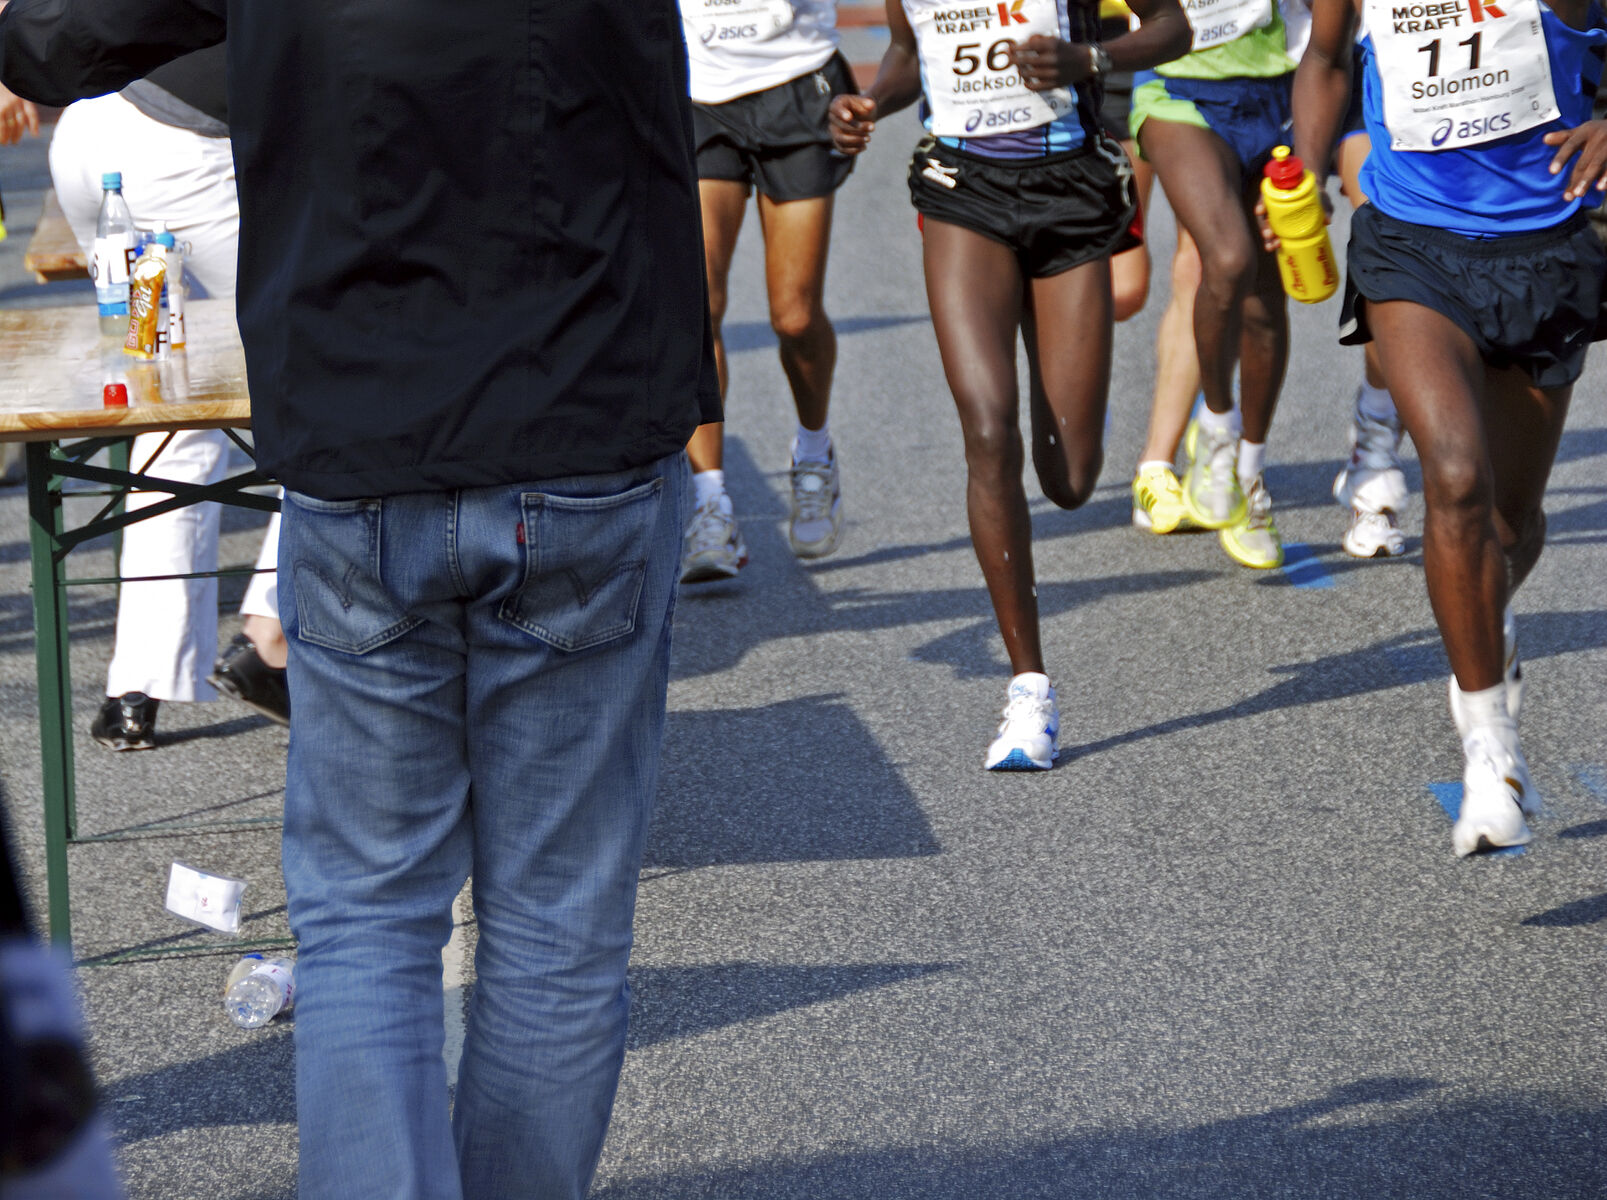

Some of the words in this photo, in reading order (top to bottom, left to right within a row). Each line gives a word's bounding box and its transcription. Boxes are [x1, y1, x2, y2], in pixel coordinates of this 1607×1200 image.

[718, 23, 758, 41] asics
[937, 18, 993, 35] KRAFT
[1200, 20, 1239, 41] asics
[1394, 14, 1463, 35] KRAFT
[952, 38, 1018, 76] 56
[1418, 30, 1484, 78] 11
[1412, 69, 1510, 100] Solomon
[985, 106, 1033, 127] asics
[1457, 112, 1512, 140] asics
